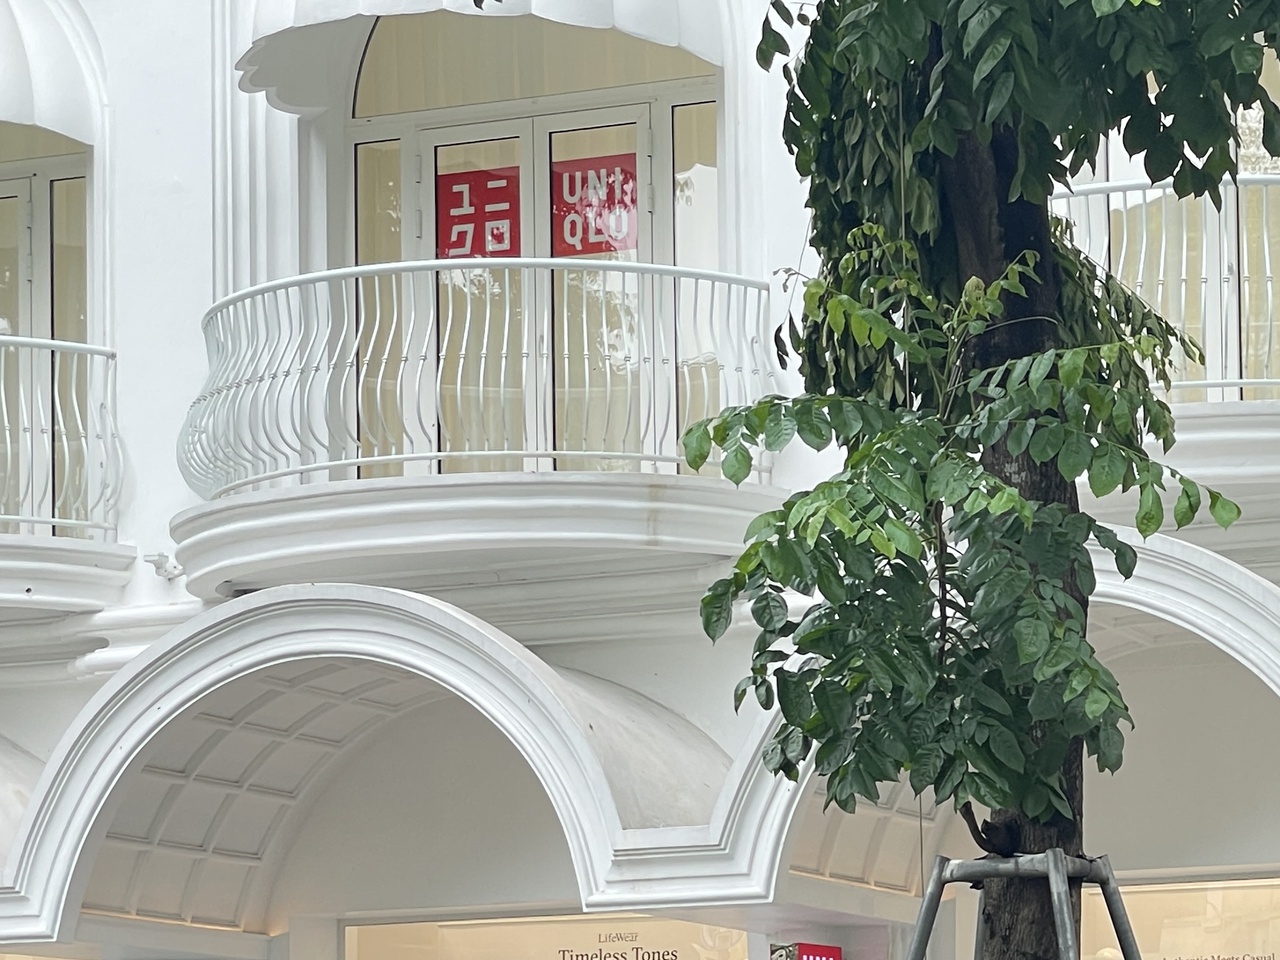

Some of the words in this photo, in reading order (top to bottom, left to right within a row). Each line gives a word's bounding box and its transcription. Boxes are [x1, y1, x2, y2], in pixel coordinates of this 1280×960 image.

[449, 178, 511, 216] ユニ
[562, 167, 622, 204] UNI
[448, 219, 511, 256] クロ
[563, 207, 629, 251] QLO
[597, 932, 639, 944] LifeWear
